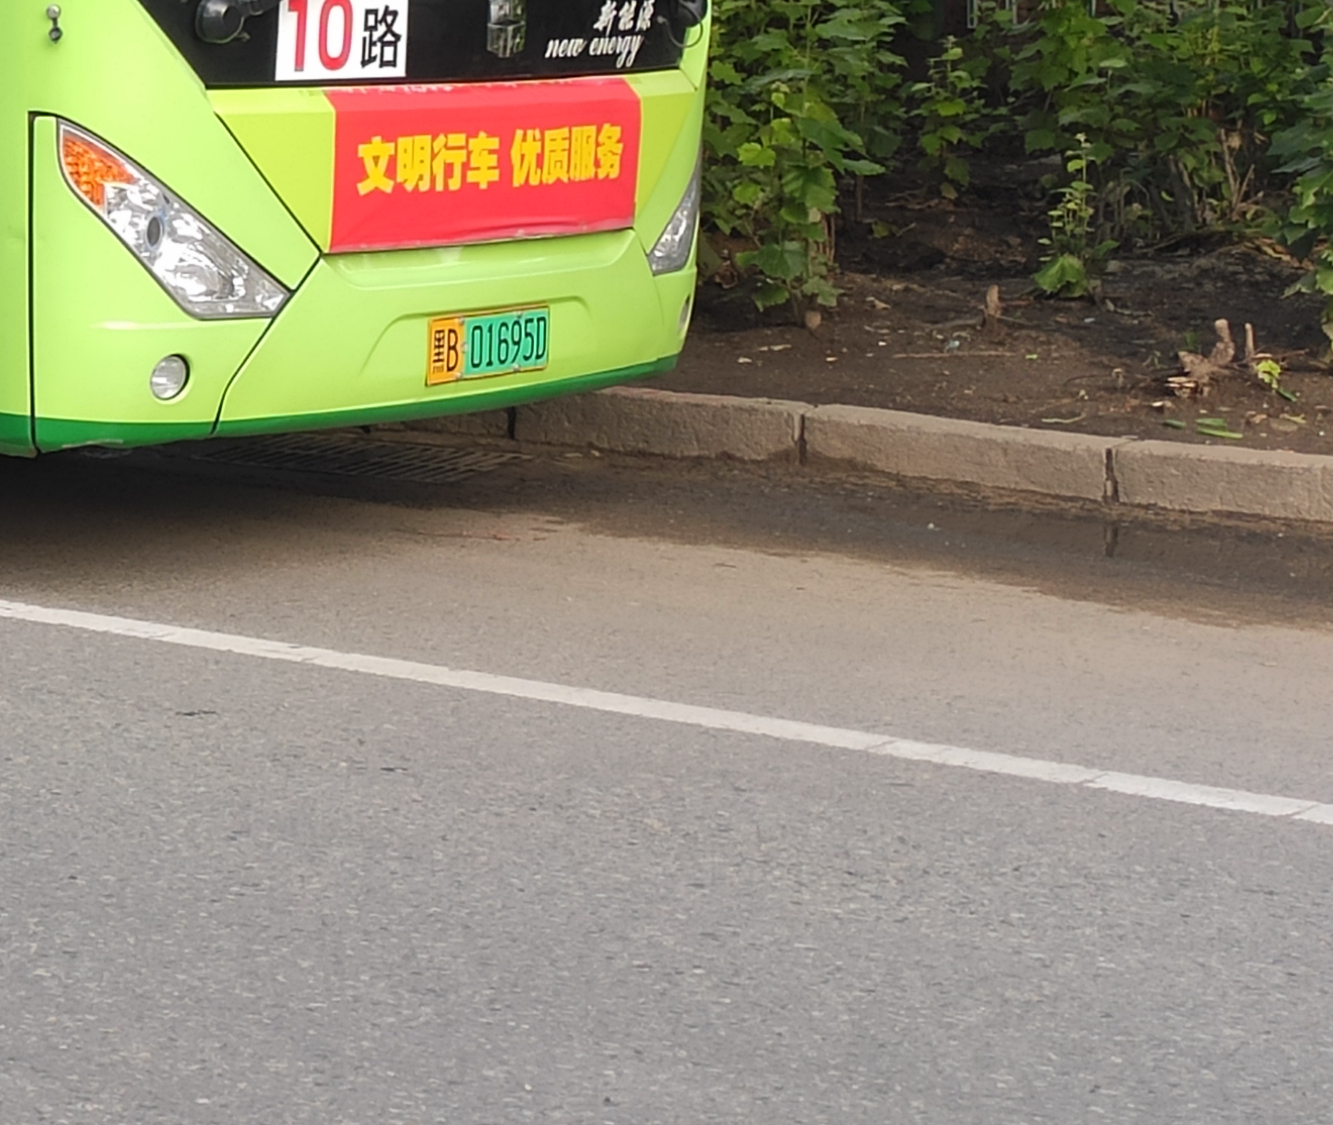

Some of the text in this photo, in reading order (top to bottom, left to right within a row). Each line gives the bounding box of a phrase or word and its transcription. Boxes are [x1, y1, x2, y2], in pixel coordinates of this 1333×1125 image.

[545, 35, 644, 69] new energy
[357, 123, 624, 196] 文明行车 优质服务
